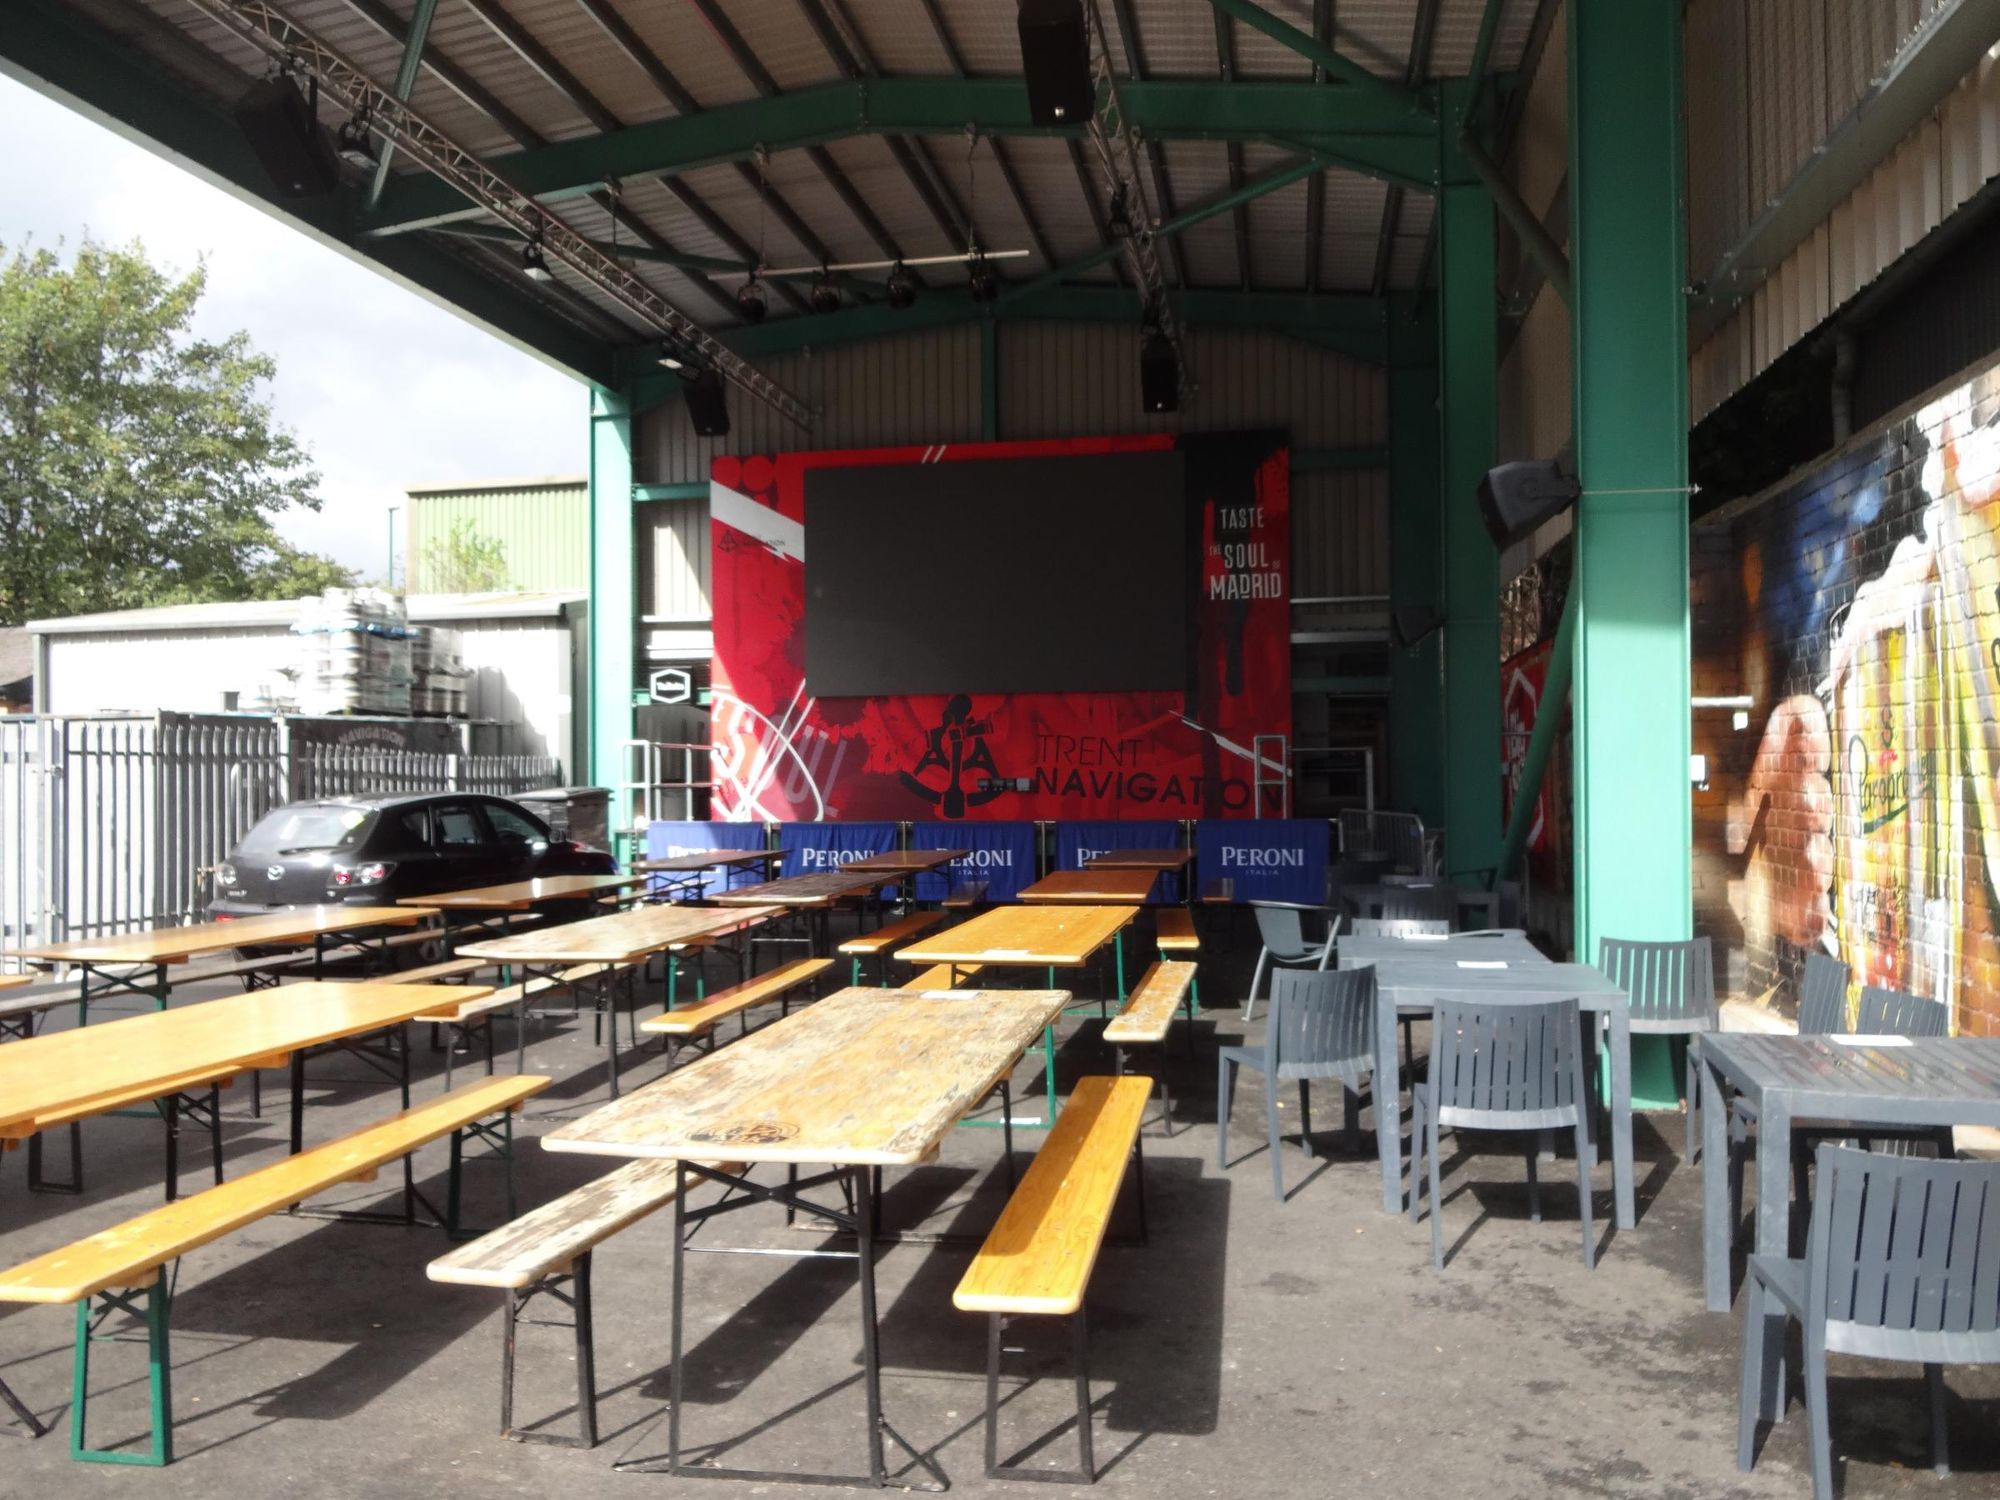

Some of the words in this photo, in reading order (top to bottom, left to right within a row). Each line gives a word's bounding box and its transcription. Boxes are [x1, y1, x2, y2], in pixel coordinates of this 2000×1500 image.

[1220, 506, 1265, 529] TASTE
[1224, 543, 1269, 569] SOUL
[1210, 572, 1282, 600] MADRID
[338, 727, 406, 752] NAVIGATION
[1038, 733, 1145, 768] TRENT
[1221, 846, 1305, 867] PERONI
